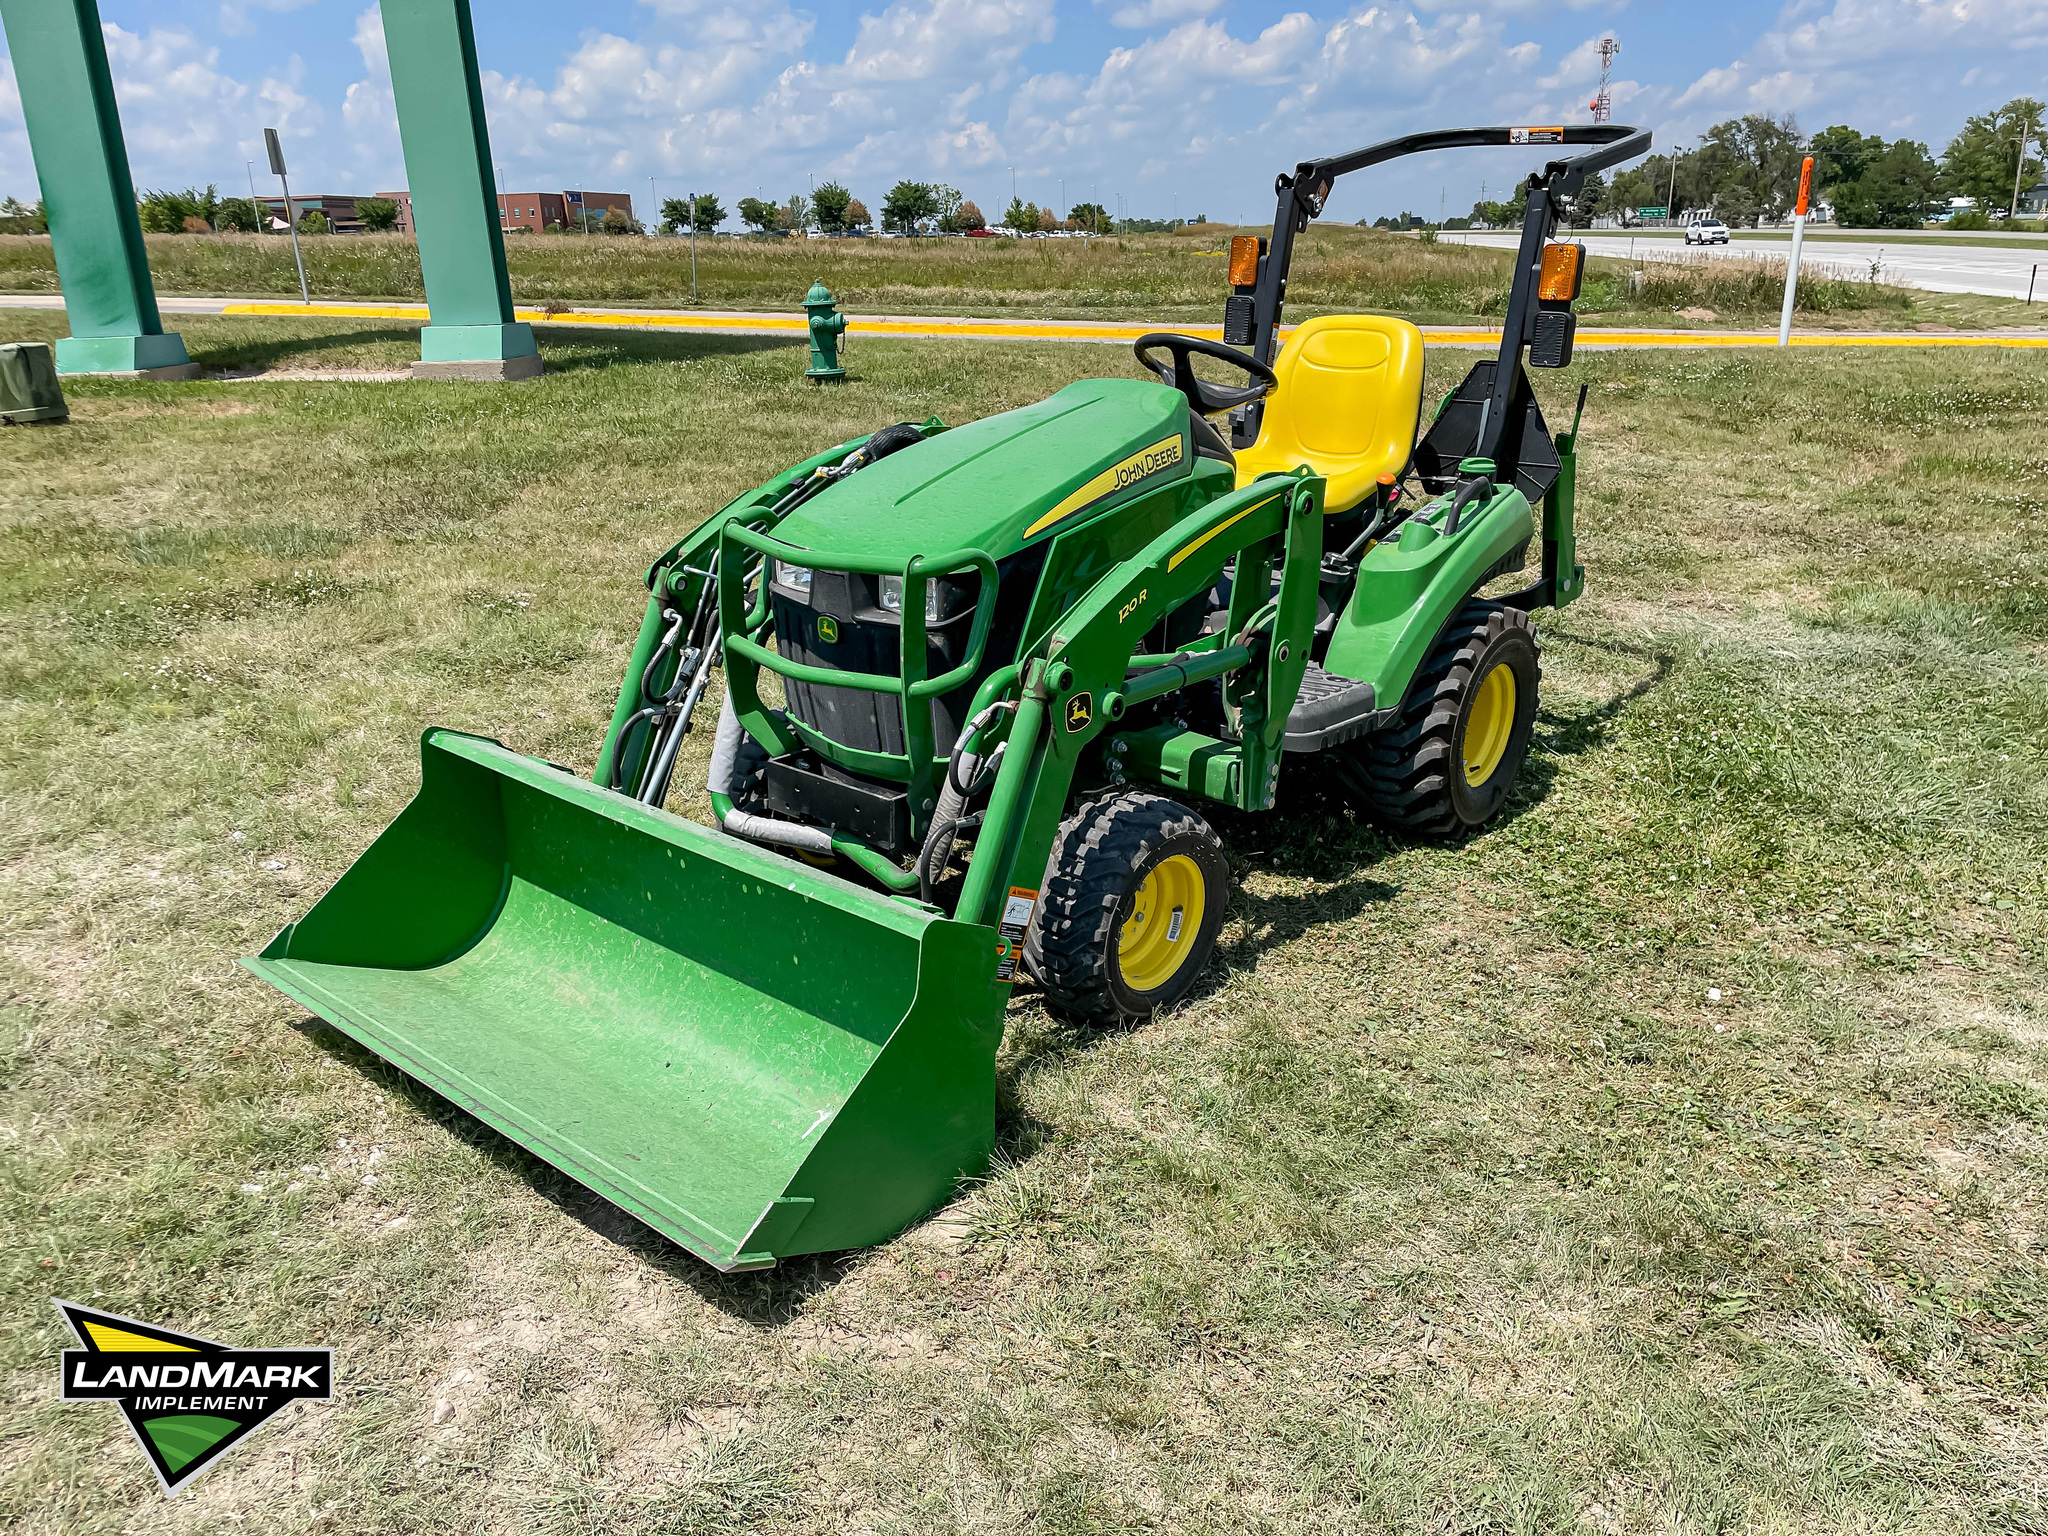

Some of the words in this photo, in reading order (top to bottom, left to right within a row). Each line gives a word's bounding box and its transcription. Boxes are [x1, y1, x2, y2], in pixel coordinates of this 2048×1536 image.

[1114, 460, 1145, 489] JOHN
[1145, 445, 1179, 474] DEERE
[1118, 597, 1138, 624] 120
[1139, 588, 1147, 605] R
